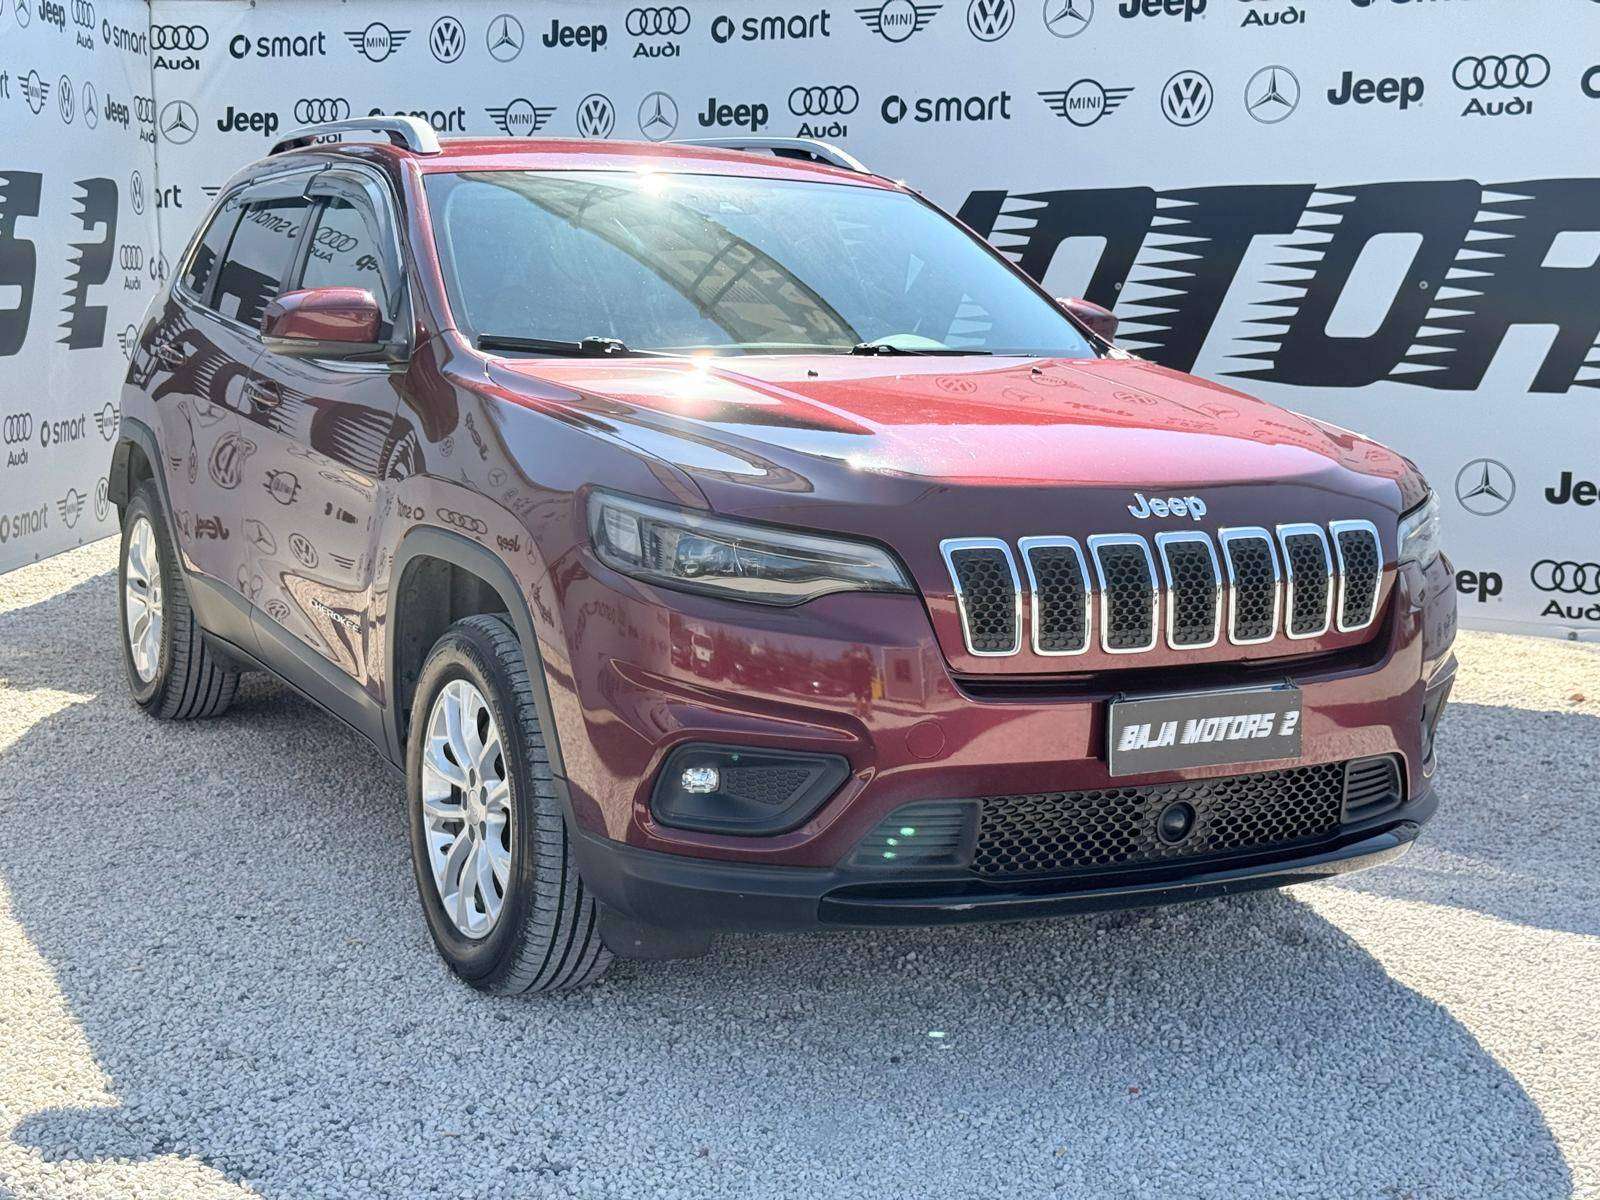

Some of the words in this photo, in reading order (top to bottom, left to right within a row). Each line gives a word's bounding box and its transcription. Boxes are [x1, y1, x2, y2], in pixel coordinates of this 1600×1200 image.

[742, 9, 830, 40] smart
[883, 13, 914, 27] MINI
[1240, 8, 1306, 27] Audi
[76, 30, 94, 51] Audi
[113, 25, 147, 56] smart
[257, 31, 326, 57] smart
[366, 37, 389, 48] MINI
[542, 19, 608, 52] Jeep
[153, 56, 200, 70] Audi
[632, 42, 681, 58] Audi
[1069, 96, 1101, 110] MINI
[1327, 71, 1424, 110] Jeep
[104, 93, 130, 130] Jeep
[508, 113, 533, 125] MINI
[698, 97, 769, 131] Jeep
[914, 91, 1011, 122] smart
[1461, 97, 1533, 117] Audi
[217, 106, 279, 136] Jeep
[797, 122, 848, 138] Audi
[124, 276, 141, 290] Audi
[52, 413, 86, 444] smart
[7, 448, 28, 468] Audi
[1545, 471, 1600, 506] Je
[1127, 493, 1207, 520] Jeep
[13, 502, 48, 539] smart
[1455, 570, 1503, 602] ep
[1540, 599, 1600, 621] Aud
[1180, 712, 1276, 744] MOTORS
[1278, 710, 1300, 736] 2
